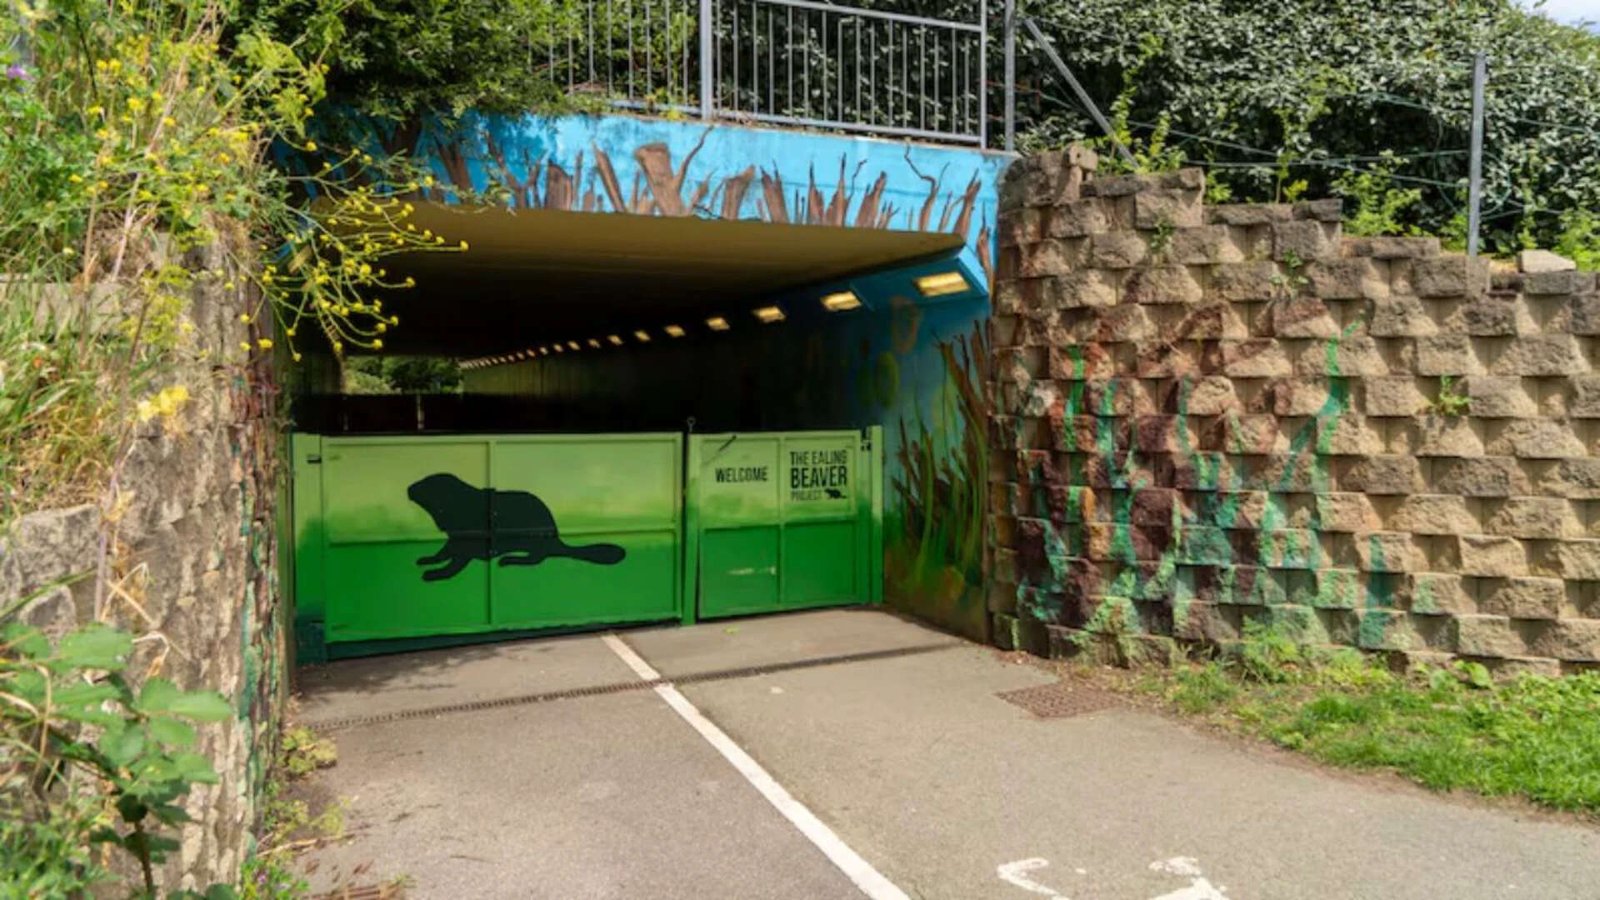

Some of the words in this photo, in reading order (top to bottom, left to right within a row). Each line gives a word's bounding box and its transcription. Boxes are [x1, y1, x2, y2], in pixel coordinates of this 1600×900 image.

[790, 451, 809, 465] THE
[811, 450, 847, 465] EALING
[715, 466, 768, 483] WELCOME
[791, 466, 847, 488] BEAVER
